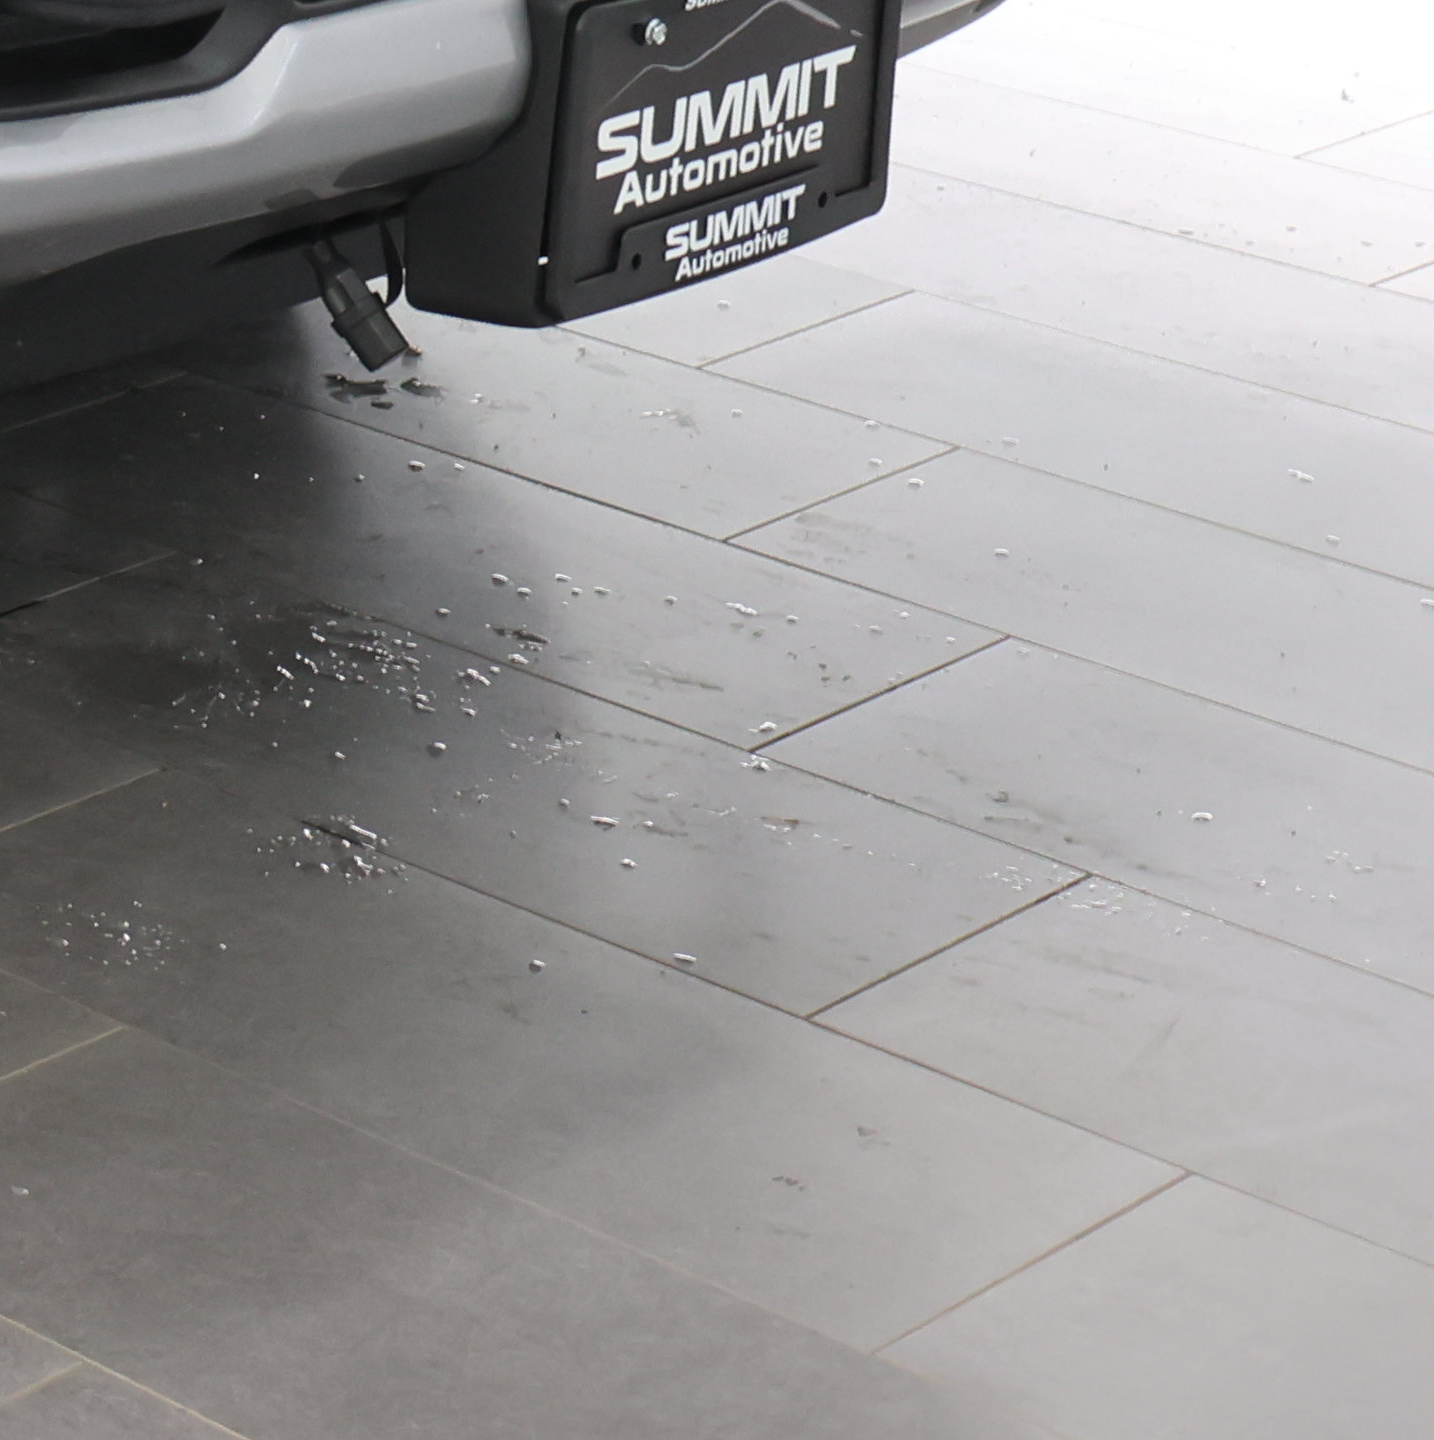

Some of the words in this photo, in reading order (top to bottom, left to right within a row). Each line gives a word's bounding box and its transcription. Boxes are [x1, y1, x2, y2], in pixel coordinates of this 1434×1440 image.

[595, 44, 857, 181] SUMMIT
[613, 120, 824, 215] Automotive
[664, 184, 806, 263] SUMMIT
[674, 226, 790, 282] Automotive
